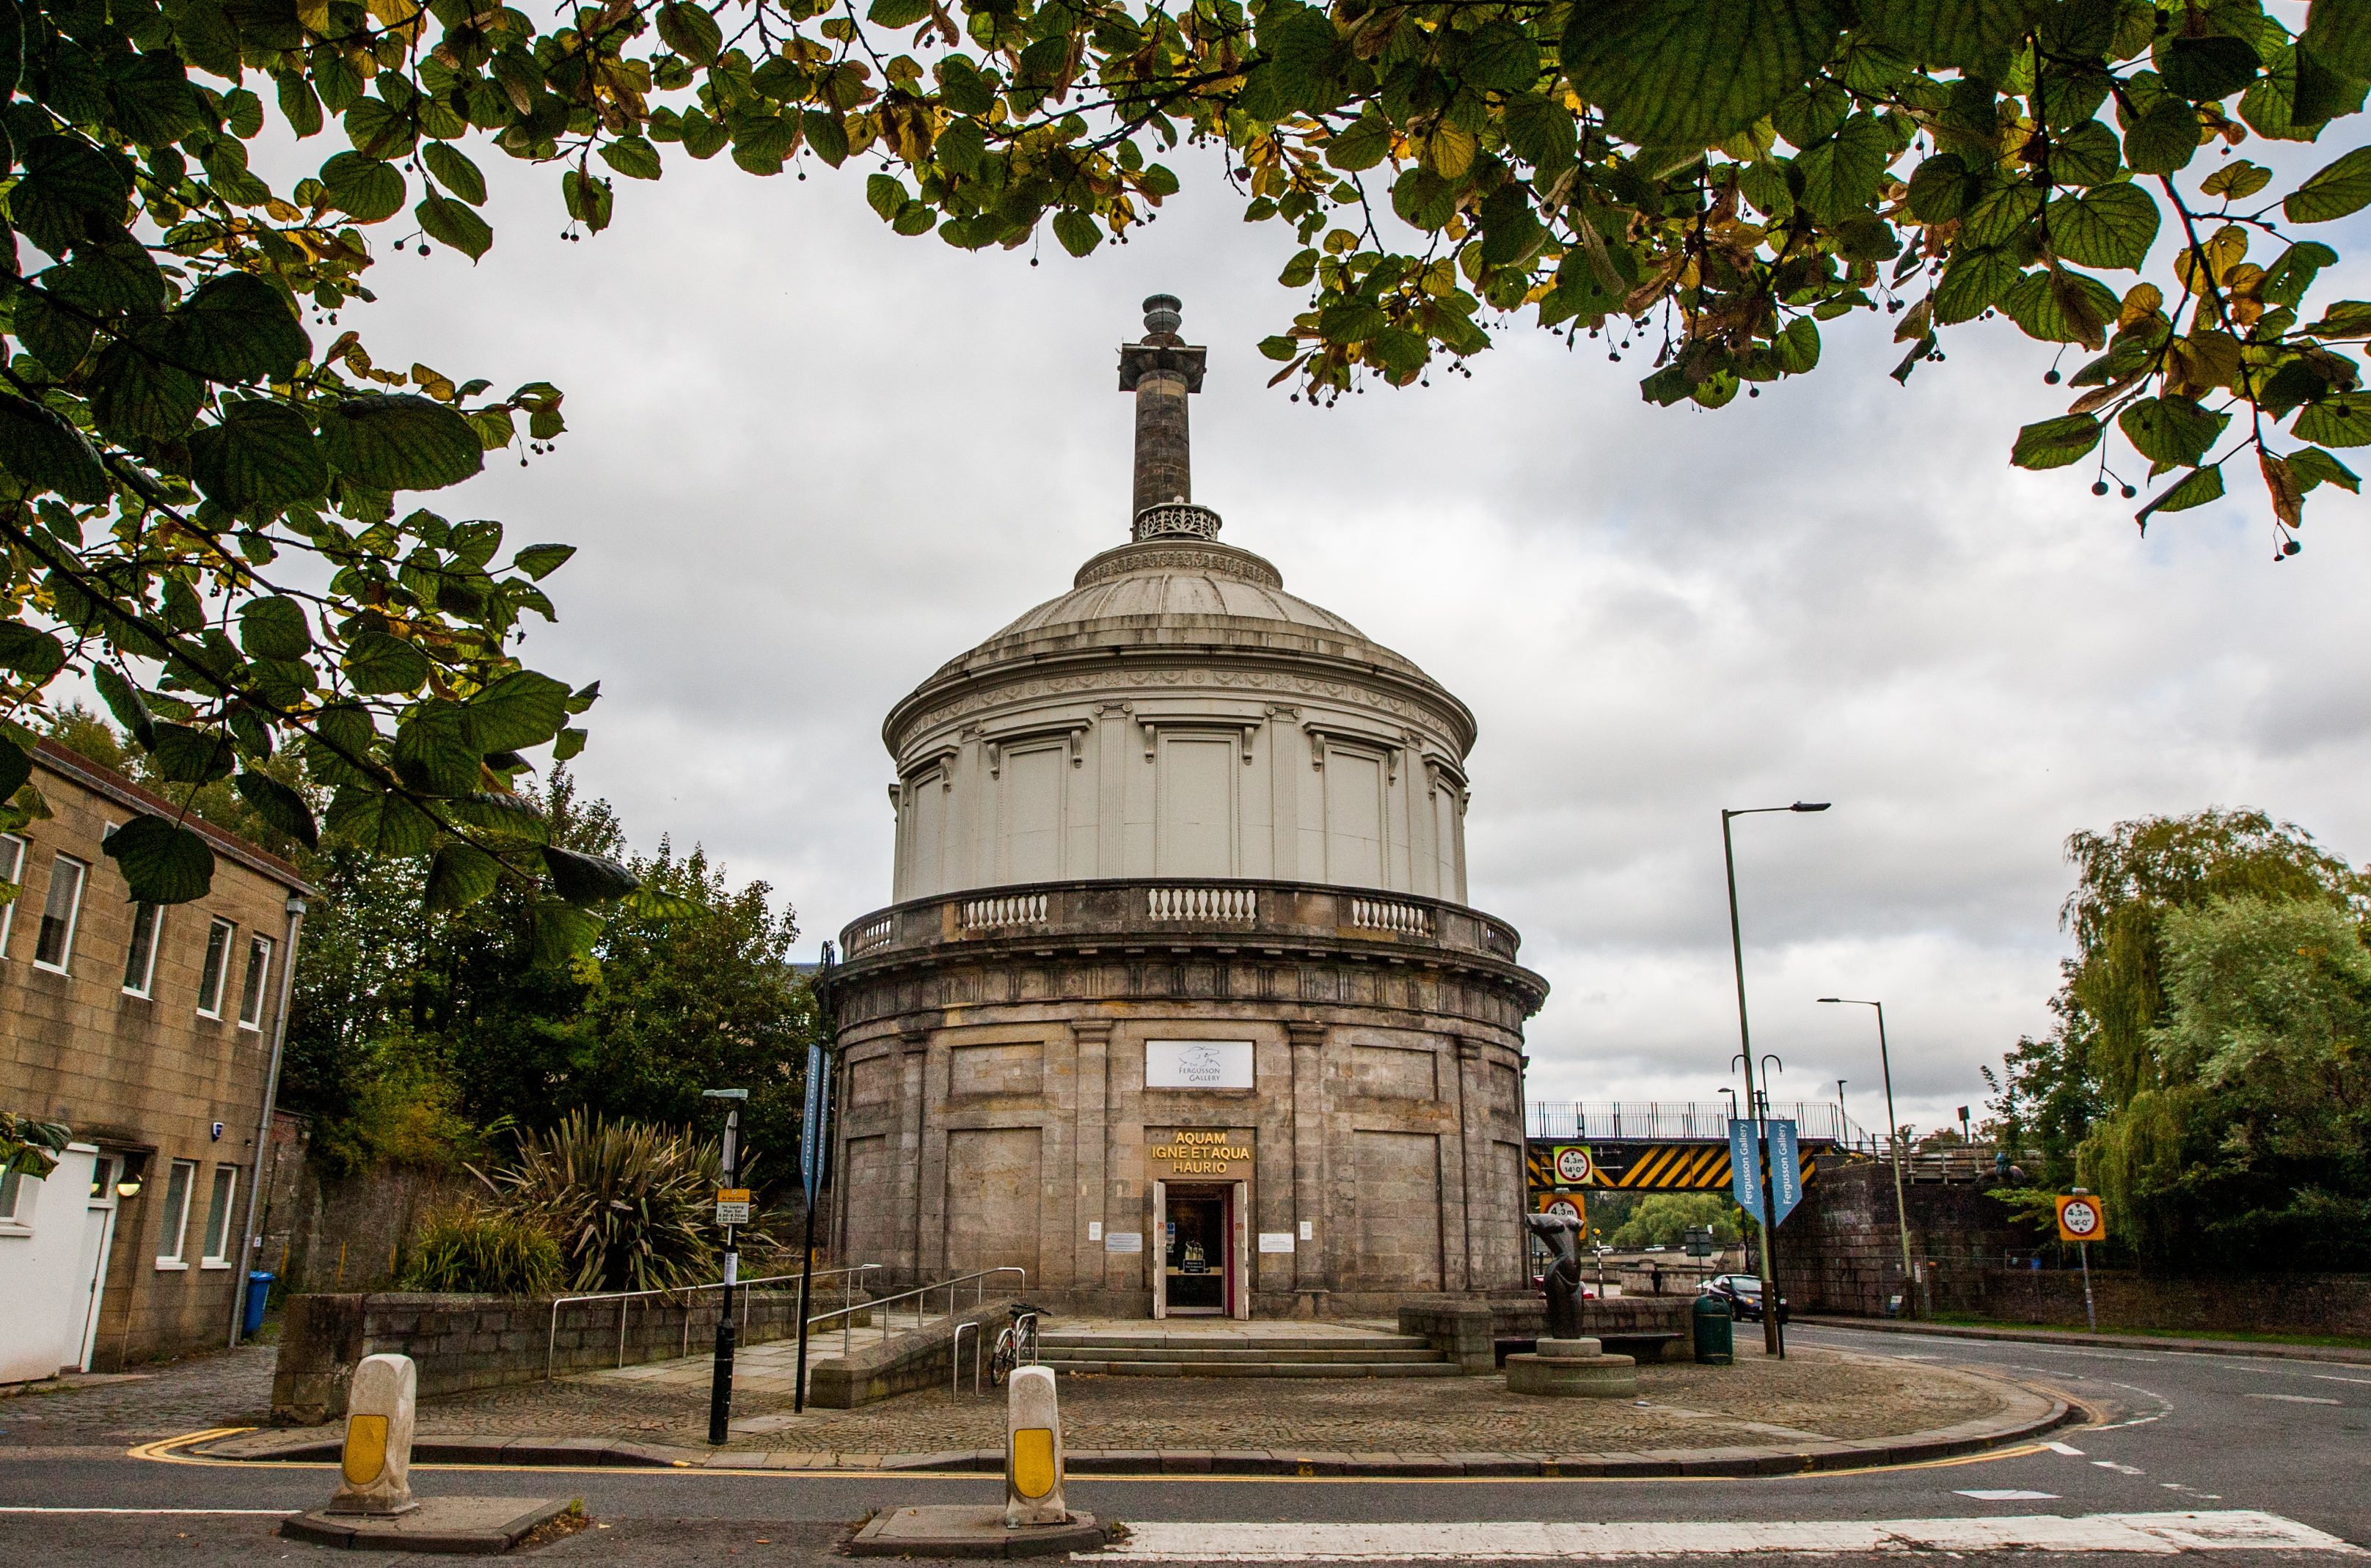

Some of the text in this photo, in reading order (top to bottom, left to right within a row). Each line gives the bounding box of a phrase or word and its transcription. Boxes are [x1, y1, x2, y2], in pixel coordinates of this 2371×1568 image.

[1175, 1132, 1226, 1146] AQUAM
[1152, 1146, 1249, 1160] IGNE ET AQUA
[1173, 1162, 1227, 1173] HAURIO
[1739, 1123, 1753, 1204] Fergusson Gallery
[1778, 1123, 1792, 1204] Fergusson Gallery
